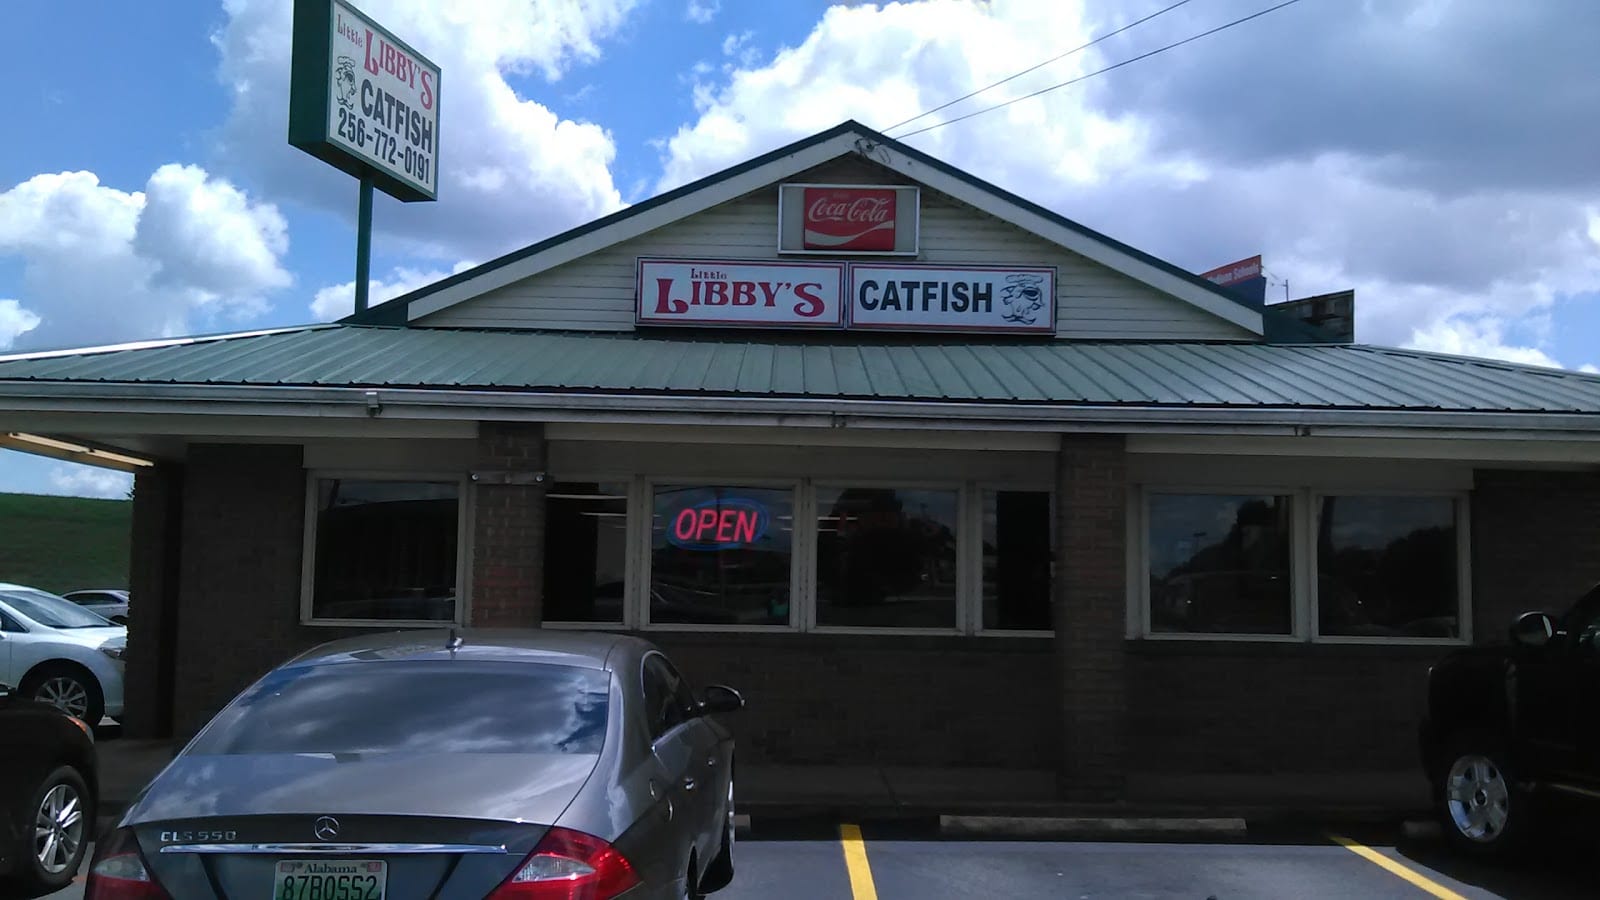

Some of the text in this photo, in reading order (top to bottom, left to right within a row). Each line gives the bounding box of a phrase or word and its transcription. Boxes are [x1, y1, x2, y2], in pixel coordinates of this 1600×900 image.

[337, 14, 363, 48] Little
[364, 29, 433, 110] LIBBY'S
[361, 79, 432, 153] CATFISH
[338, 107, 430, 184] 256-772-0191
[808, 197, 889, 222] Coca-Cola
[690, 268, 727, 279] Little
[654, 278, 825, 317] LIBBY'S
[859, 280, 993, 313] CATFISH
[675, 508, 758, 543] OPEN
[160, 830, 237, 842] CLS 550
[304, 863, 358, 873] Alabama
